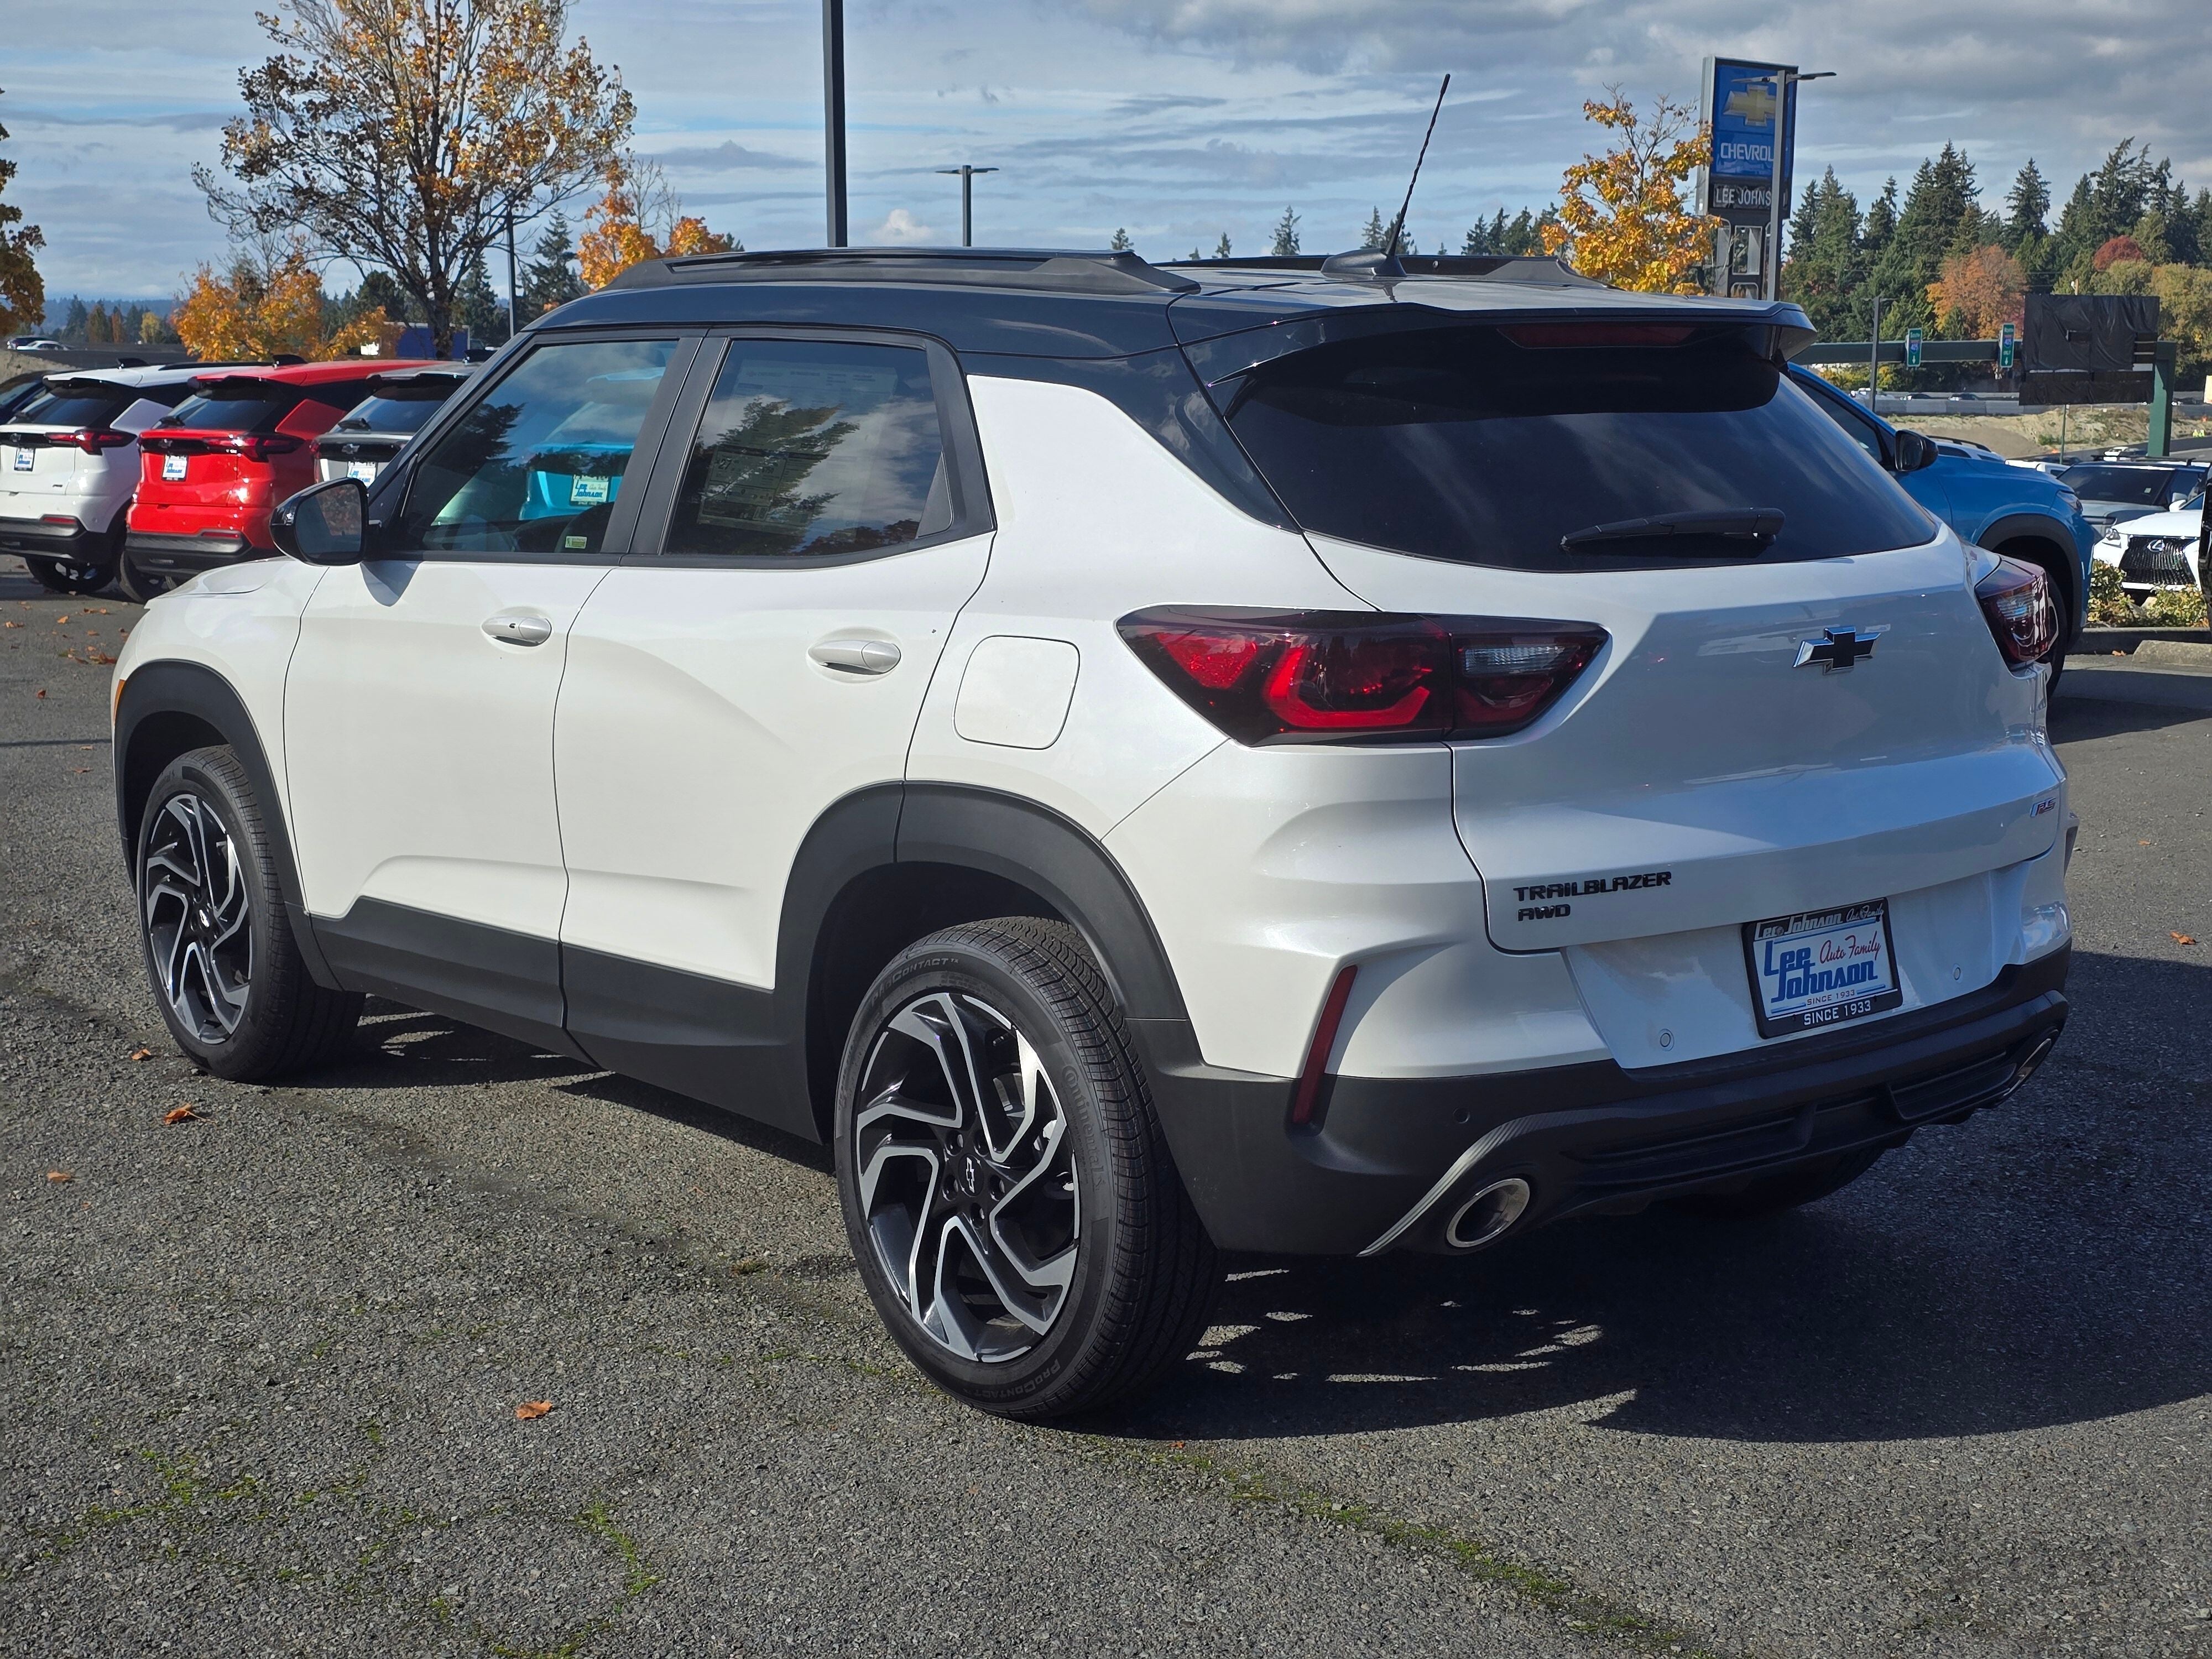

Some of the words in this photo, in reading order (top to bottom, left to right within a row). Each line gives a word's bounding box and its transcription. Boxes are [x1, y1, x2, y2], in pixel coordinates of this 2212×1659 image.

[1720, 142, 1775, 161] CHEVROL
[1716, 188, 1735, 204] LEE
[1738, 189, 1772, 206] JOHNS
[2030, 797, 2057, 818] RS
[1513, 871, 1672, 902] TRAILBLAZER
[1517, 904, 1571, 922] AWD
[1785, 913, 1844, 935] Johnson
[1764, 940, 1812, 977] Lee
[1819, 940, 1846, 964] Auto
[1845, 931, 1881, 961] Family
[1771, 960, 1878, 1004] Johnson
[1807, 994, 1832, 1005] SINCE
[1836, 989, 1855, 999] 1933
[1804, 1007, 1839, 1026] SINCE
[1844, 1000, 1871, 1017] 1933
